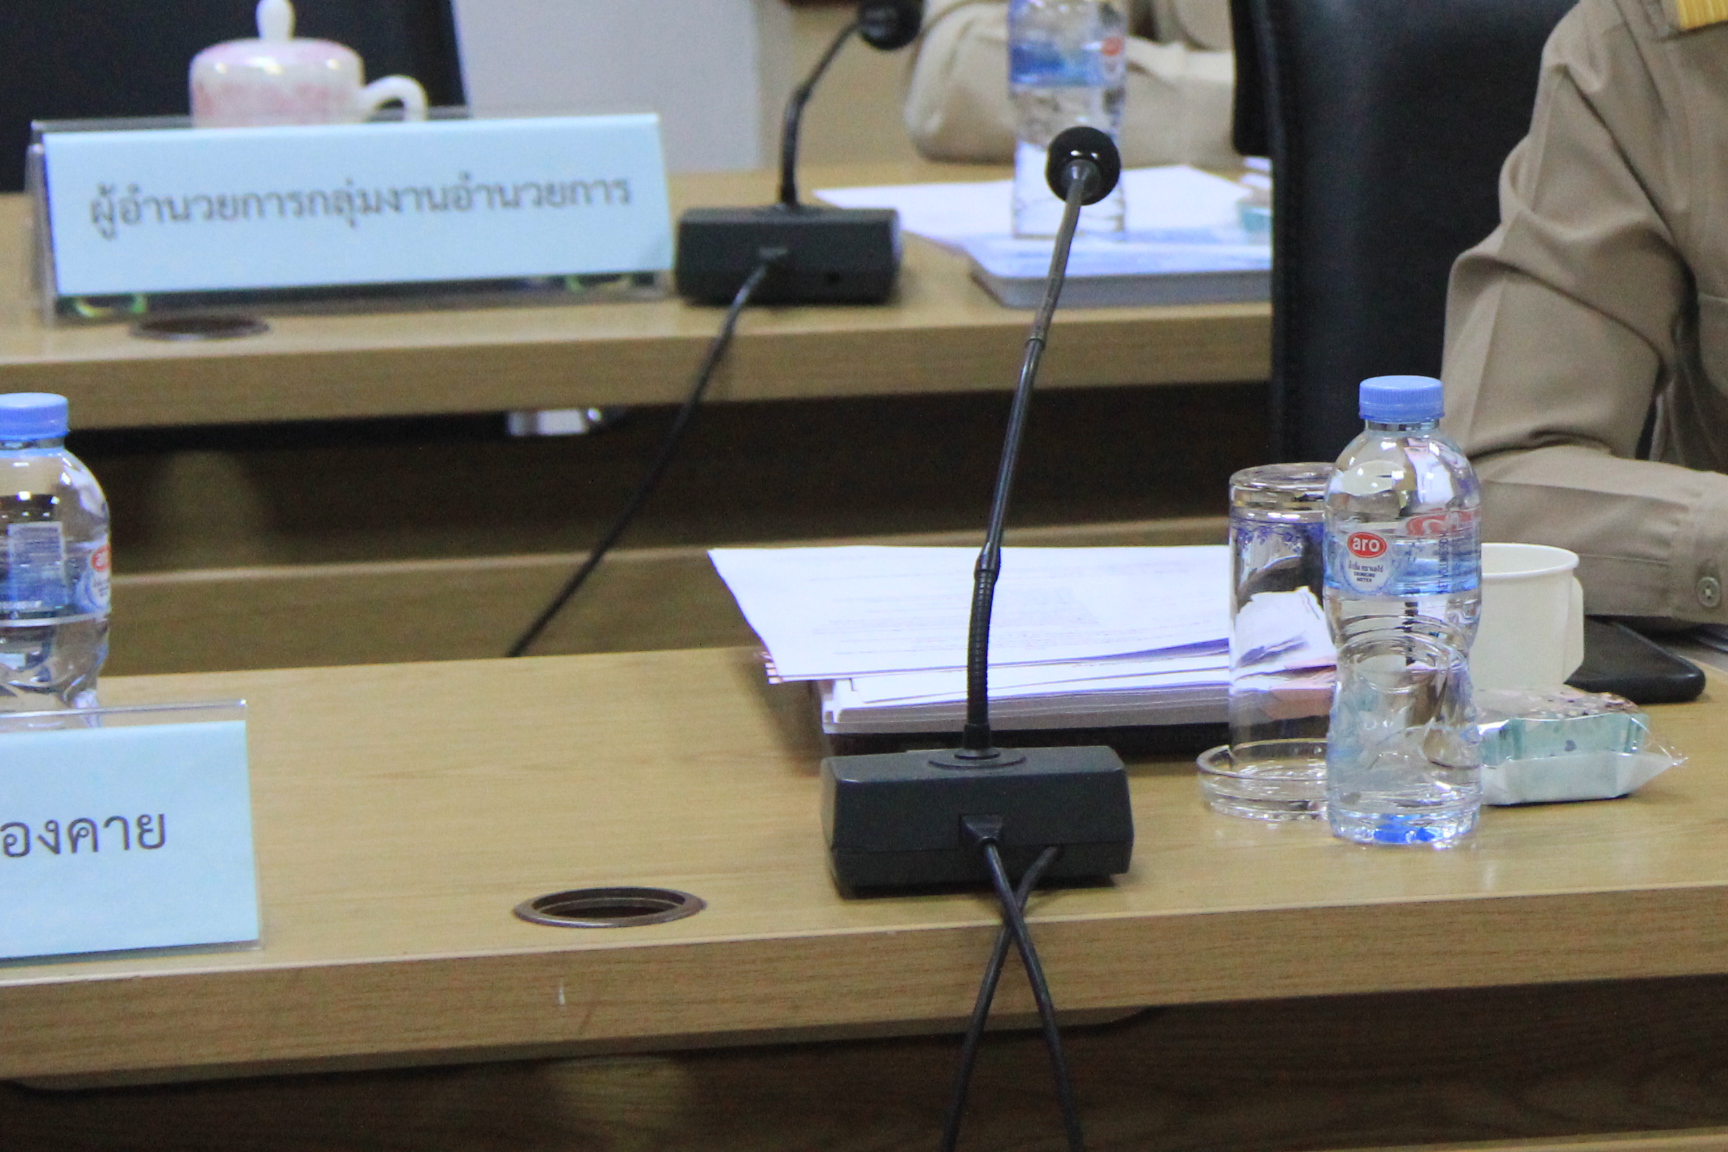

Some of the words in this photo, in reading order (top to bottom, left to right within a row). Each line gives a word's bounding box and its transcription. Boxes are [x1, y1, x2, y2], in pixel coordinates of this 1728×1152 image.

[89, 172, 634, 243] ผู้อำนวยการกลุ่มงานอำนวยการ
[1352, 537, 1380, 552] aro
[0, 813, 166, 858] องคาย
